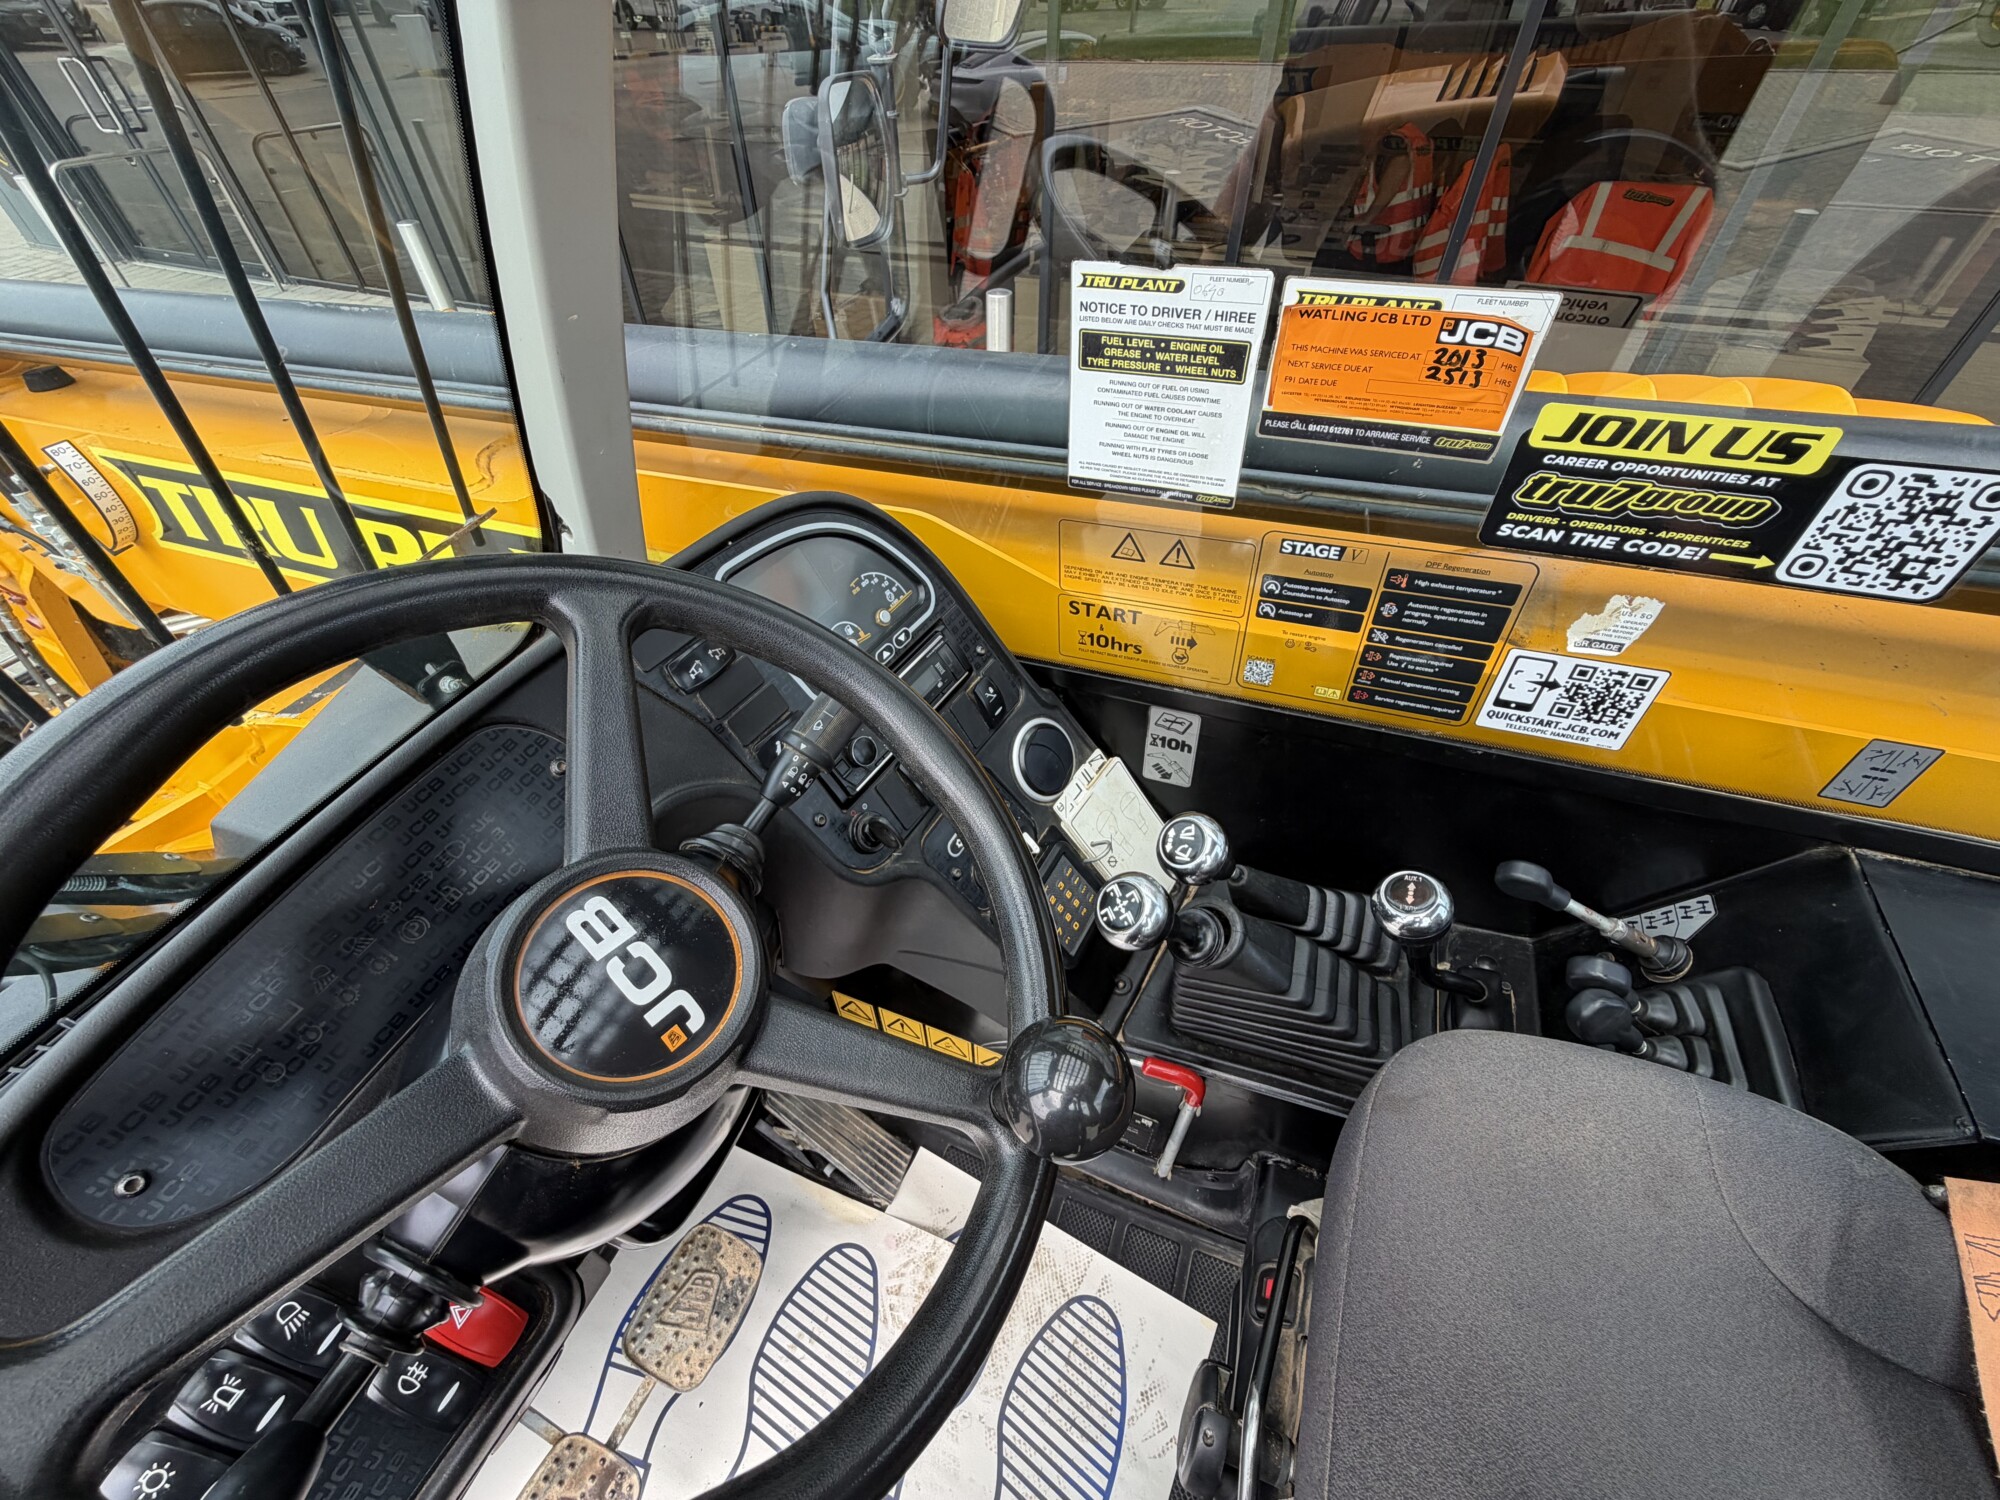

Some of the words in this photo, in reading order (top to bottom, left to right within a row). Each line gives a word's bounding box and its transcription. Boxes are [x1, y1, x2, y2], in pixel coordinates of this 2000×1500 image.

[1085, 275, 1116, 288] TRU
[1118, 277, 1179, 293] PLANT
[1079, 300, 1126, 315] NOTICE
[1131, 304, 1147, 316] TO
[1151, 305, 1201, 320] DRIVER
[1214, 309, 1256, 324] HIREE
[1498, 299, 1528, 307] NUMBER
[1561, 298, 1607, 311] vehic
[1078, 315, 1099, 323] LISTED
[1100, 316, 1123, 325] BELOW
[1123, 318, 1137, 326] ARE
[1137, 319, 1156, 327] DAILY
[1156, 320, 1184, 329] CHECKS
[1185, 322, 1201, 330] THAT
[1203, 324, 1222, 332] MUST
[1234, 326, 1254, 334] MADE
[1298, 308, 1367, 322] WATLING
[1370, 311, 1398, 323] JCB
[1403, 314, 1432, 327] LTD
[1100, 335, 1124, 346] FUEL
[1126, 337, 1155, 348] LEVEL
[1169, 341, 1206, 352] ENGINE
[1208, 344, 1224, 354] OIL
[1439, 320, 1525, 353] JCB
[1103, 347, 1141, 358] GREASE
[1154, 351, 1188, 362] WATER
[1190, 354, 1219, 365] LEVEL
[1291, 342, 1308, 352] THIS
[1309, 344, 1348, 355] MACHINE
[1349, 347, 1368, 356] WAS
[1369, 348, 1409, 360] SERVICED
[1410, 353, 1422, 361] AT
[1433, 347, 1488, 369] 2013
[1086, 356, 1110, 367] TYRE
[1111, 358, 1161, 371] PRESSURE
[1174, 364, 1208, 376] WHEEL
[1210, 367, 1236, 378] NUTS
[1287, 359, 1308, 368] NEXT
[1310, 360, 1342, 371] SERVICE
[1343, 363, 1361, 372] DUE
[1361, 364, 1372, 373] AT
[1500, 361, 1518, 373] HRS
[1283, 375, 1295, 384] F91
[1298, 376, 1318, 385] DATE
[1319, 377, 1338, 386] DUE
[1425, 366, 1483, 388] 2513
[1495, 377, 1513, 388] HRS
[1096, 386, 1142, 397] CONTAMINATED
[1143, 390, 1159, 398] FUEL
[1160, 392, 1185, 401] CAUSES
[1186, 395, 1220, 404] DOWNTIME
[1108, 379, 1136, 388] RUNNING
[1137, 381, 1150, 389] OUT
[1189, 386, 1209, 394] USING
[1092, 399, 1120, 408] RUNNING
[1143, 404, 1165, 413] WATER
[1166, 406, 1196, 416] COOLANT
[1197, 410, 1222, 418] CAUSES
[1129, 411, 1152, 420] ENGINE
[1162, 414, 1194, 424] OVERHEAT
[1264, 418, 1289, 430] PLEASE
[1289, 421, 1306, 432] CALL
[1307, 422, 1329, 434] 01473
[1328, 425, 1353, 437] 612761
[1355, 427, 1364, 438] TO
[1364, 428, 1399, 441] ARRANGE
[1400, 432, 1430, 445] SERVICE
[1541, 412, 1704, 455] JOIN
[1710, 426, 1825, 467] US
[50, 446, 66, 456] 80
[1434, 437, 1493, 450] tru7.com
[65, 461, 82, 472] 70
[1542, 452, 1608, 472] CAREER
[1610, 459, 1751, 486] OPPORTUNITIES
[1751, 472, 1780, 488] AT
[81, 477, 95, 487] 60
[94, 491, 108, 501] 50
[1514, 473, 1773, 520] tru7group
[105, 504, 117, 514] 40
[112, 516, 124, 525] 30
[1506, 511, 1559, 525] DRIVERS
[1568, 519, 1646, 536] OPERATORS
[1656, 528, 1750, 548] APPRENTICES
[117, 526, 128, 534] 20
[1281, 540, 1342, 560] STAGE
[1350, 548, 1363, 562] V
[1497, 522, 1563, 546] SCAN
[1570, 530, 1618, 553] THE
[1623, 537, 1707, 563] CODE!
[1303, 568, 1334, 579] Autostop
[1424, 559, 1442, 570] DPF
[1441, 561, 1491, 576] Regeneration
[1282, 580, 1309, 591] Autostop
[1310, 584, 1333, 594] enabled
[1413, 578, 1429, 588] High
[1430, 580, 1455, 591] exhaust
[1455, 583, 1496, 596] temperature
[1281, 588, 1315, 600] Countdown
[1315, 593, 1323, 601] to
[1322, 594, 1350, 605] Autostop
[1069, 600, 1142, 625] START
[1277, 607, 1304, 618] Autostop
[1303, 610, 1312, 619] off
[1403, 608, 1432, 620] progress,
[1432, 612, 1458, 624] operate
[1458, 615, 1485, 627] machine
[1407, 600, 1439, 612] Automatic
[1439, 604, 1480, 617] regeneration
[1480, 609, 1487, 618] in
[1099, 623, 1105, 631] &
[1401, 615, 1428, 627] normally
[1087, 632, 1142, 655] 10hrs
[1394, 634, 1434, 647] Regeneration
[1434, 639, 1463, 652] cancelled
[1388, 651, 1427, 665] Regeneration
[1426, 657, 1453, 669] required
[1486, 709, 1620, 740] QUICKSTART.JCB.COM
[1505, 721, 1548, 736] TELESCOPIC
[1549, 729, 1589, 743] HANDLERS
[1158, 737, 1193, 754] 10h
[565, 895, 706, 1034] JCB
